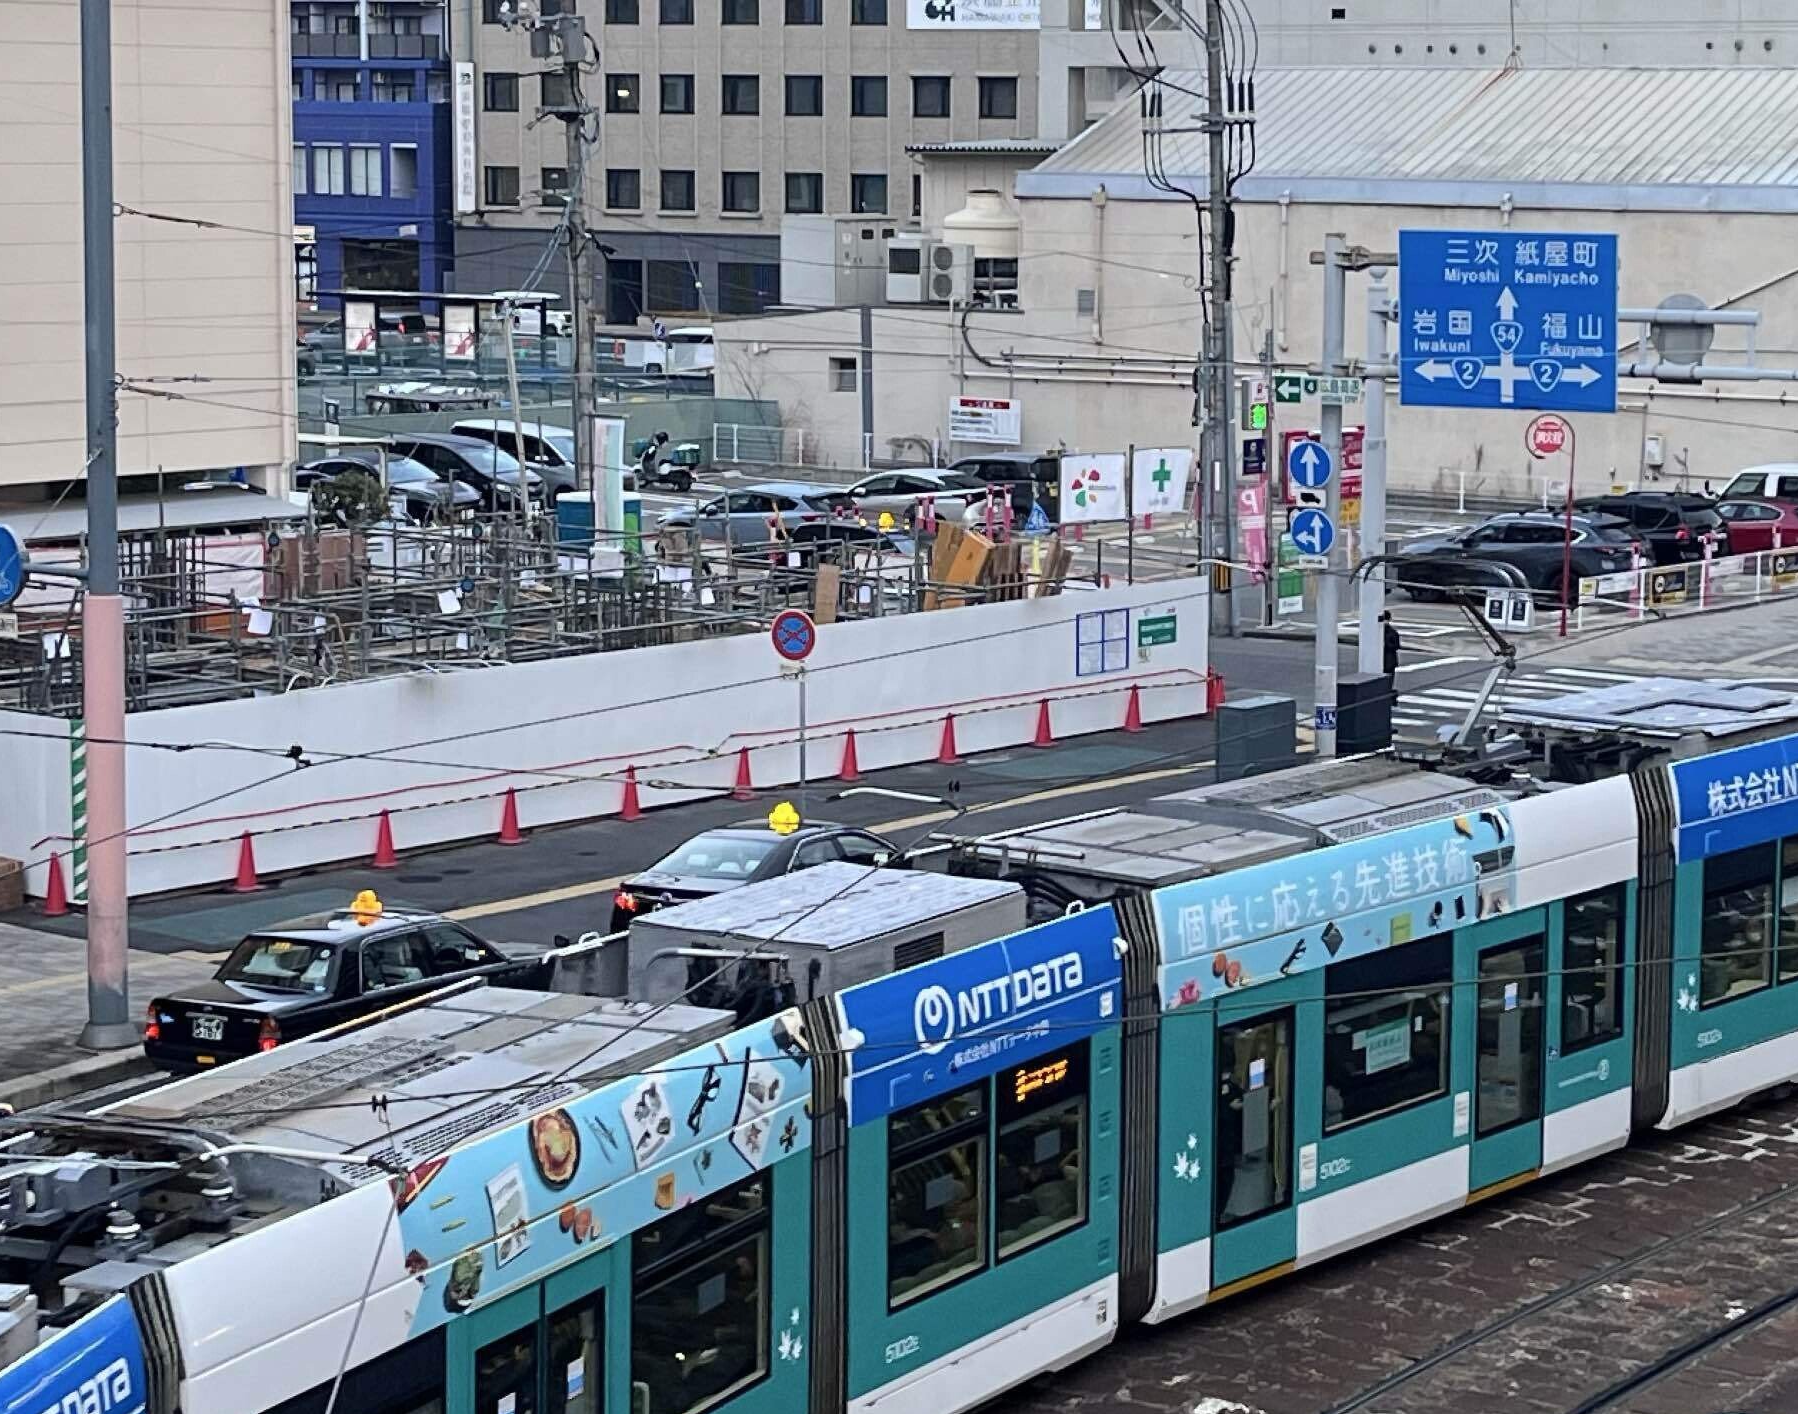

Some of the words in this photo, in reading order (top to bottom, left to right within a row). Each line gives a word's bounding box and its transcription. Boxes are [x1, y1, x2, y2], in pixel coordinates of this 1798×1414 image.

[1446, 239, 1499, 265] 三次
[1515, 240, 1598, 267] 紙屋町
[1444, 269, 1500, 285] Miyoshi
[1514, 269, 1599, 286] Kamiyacho
[1413, 309, 1472, 335] 岩国
[1542, 313, 1602, 339] 福山
[1498, 327, 1516, 342] 54
[1414, 338, 1471, 353] Iwakuni
[1540, 342, 1603, 358] Fukuyama
[1462, 362, 1474, 379] 2
[1540, 365, 1552, 382] 2
[1178, 838, 1470, 956] 個性に応える先進技術
